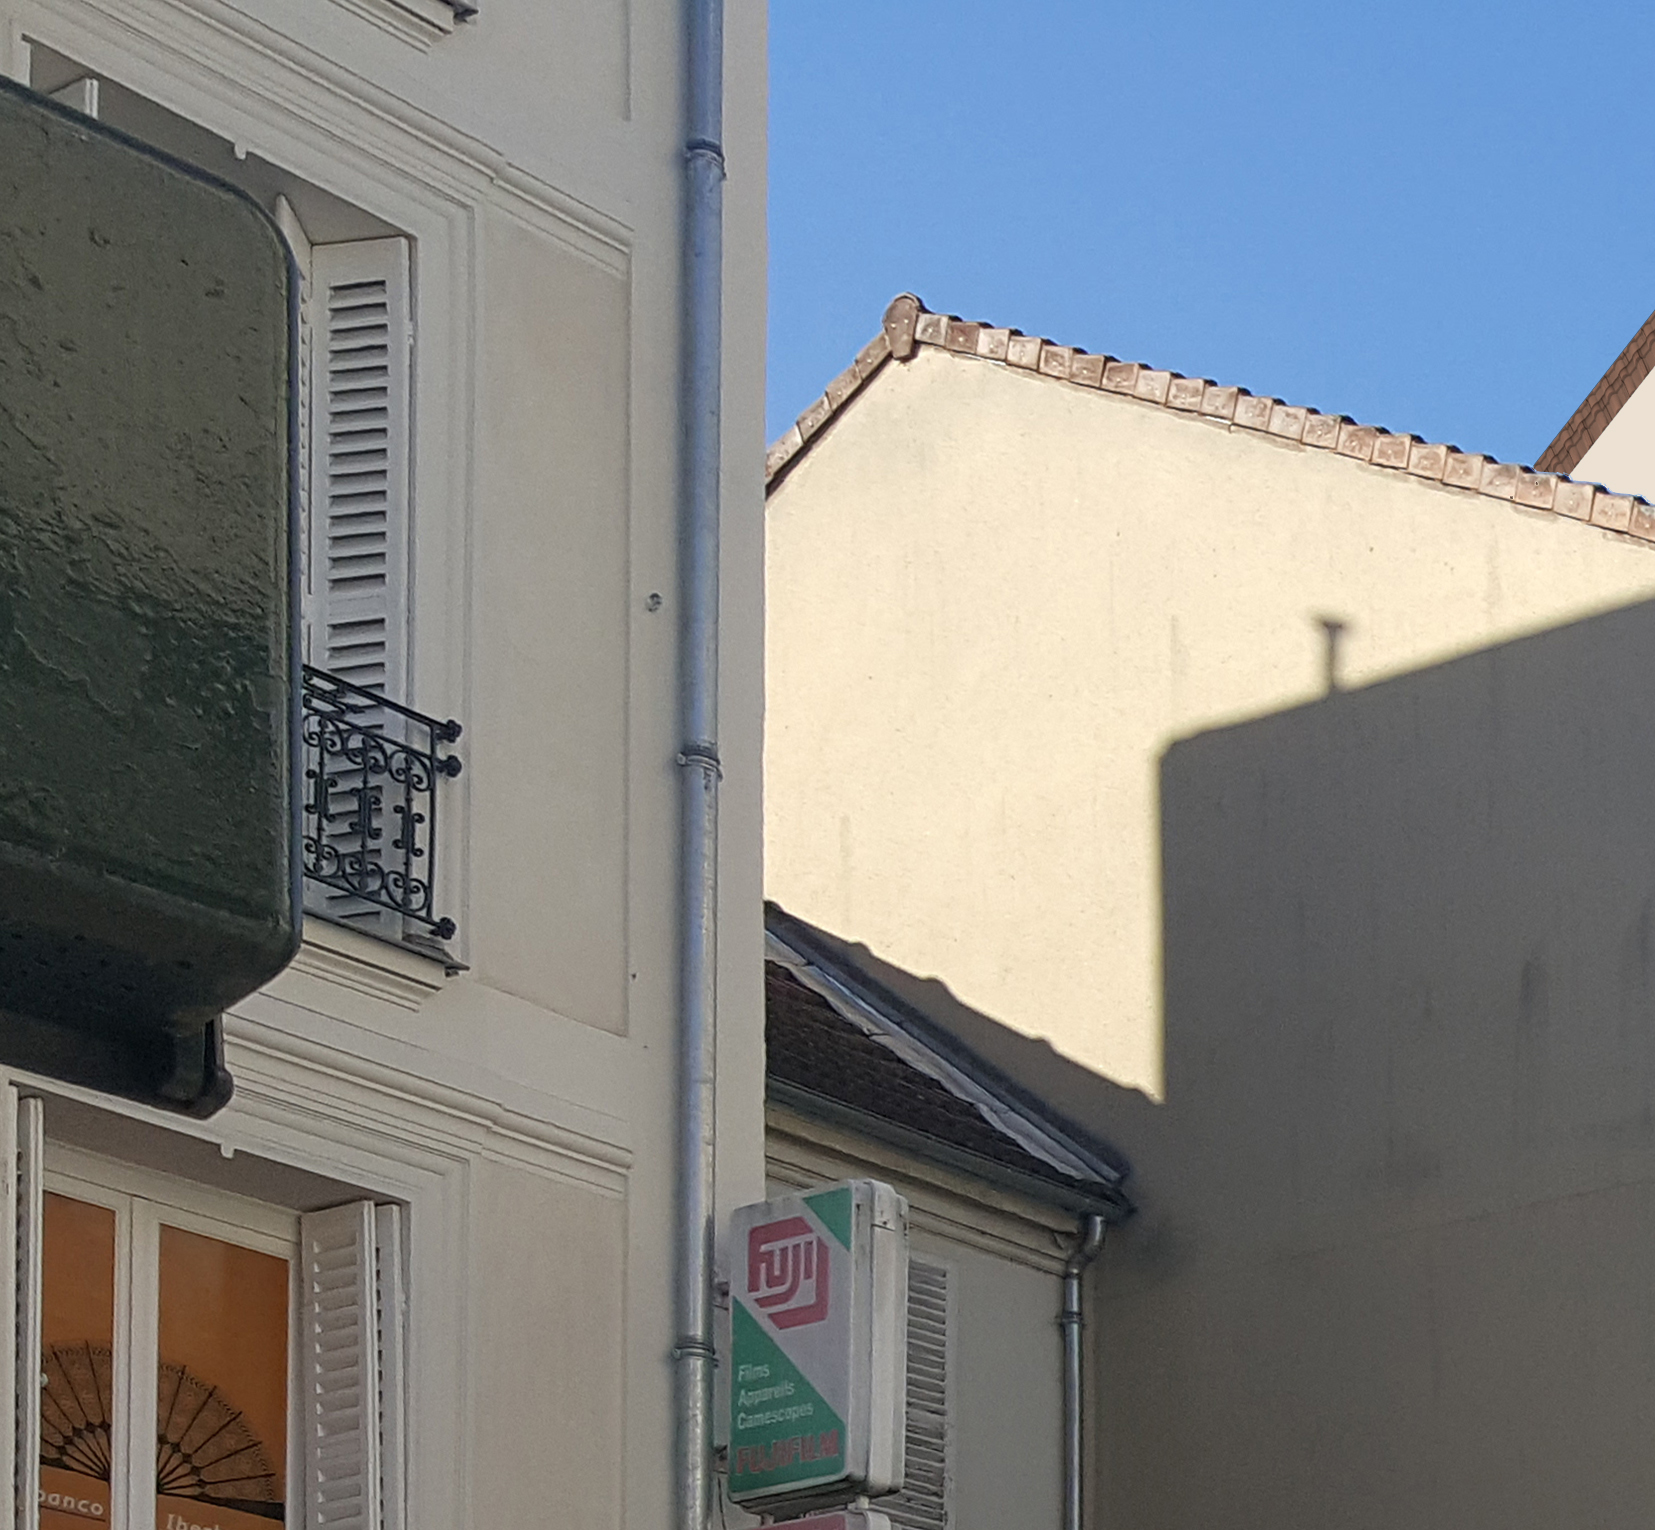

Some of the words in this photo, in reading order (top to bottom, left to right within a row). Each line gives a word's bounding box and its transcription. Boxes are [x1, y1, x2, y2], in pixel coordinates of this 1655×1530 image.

[738, 1363, 770, 1382] Films
[738, 1380, 795, 1406] Appareils
[737, 1401, 813, 1430] Camescopes
[736, 1428, 839, 1475] FUJIFILM
